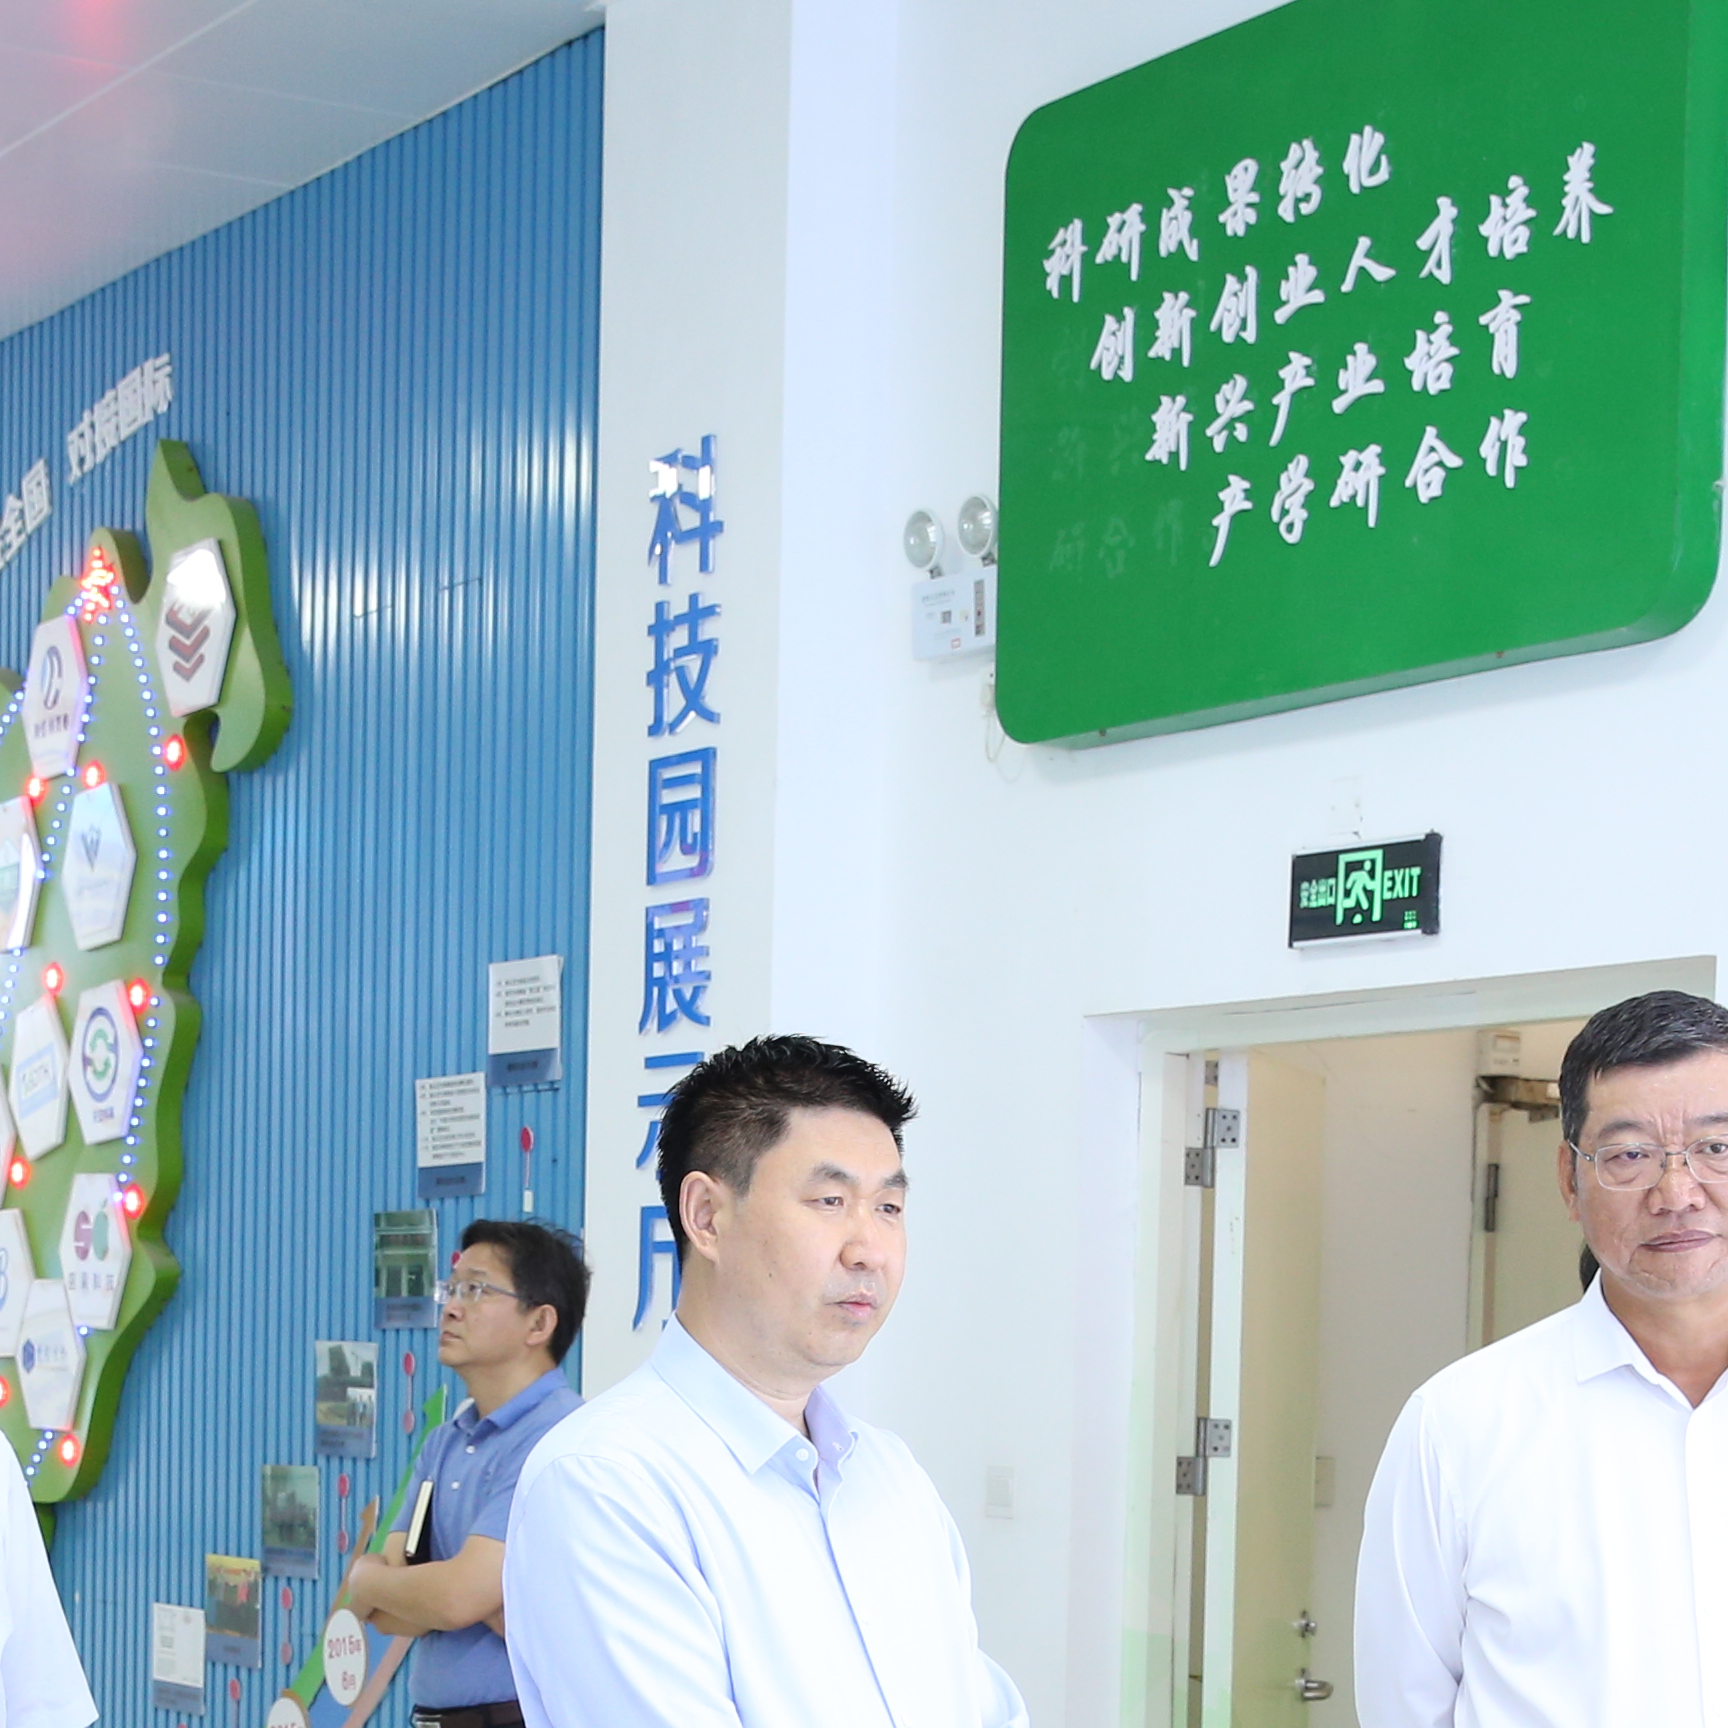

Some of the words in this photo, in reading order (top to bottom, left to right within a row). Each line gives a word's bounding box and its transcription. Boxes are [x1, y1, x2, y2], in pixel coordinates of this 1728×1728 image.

[1042, 125, 1391, 303] 科研成果转化
[1090, 141, 1613, 383] 创新创业人才培养
[1145, 289, 1531, 472] 新兴产业培育
[1209, 409, 1530, 568] 产学研合作
[1382, 866, 1422, 900] EXIT
